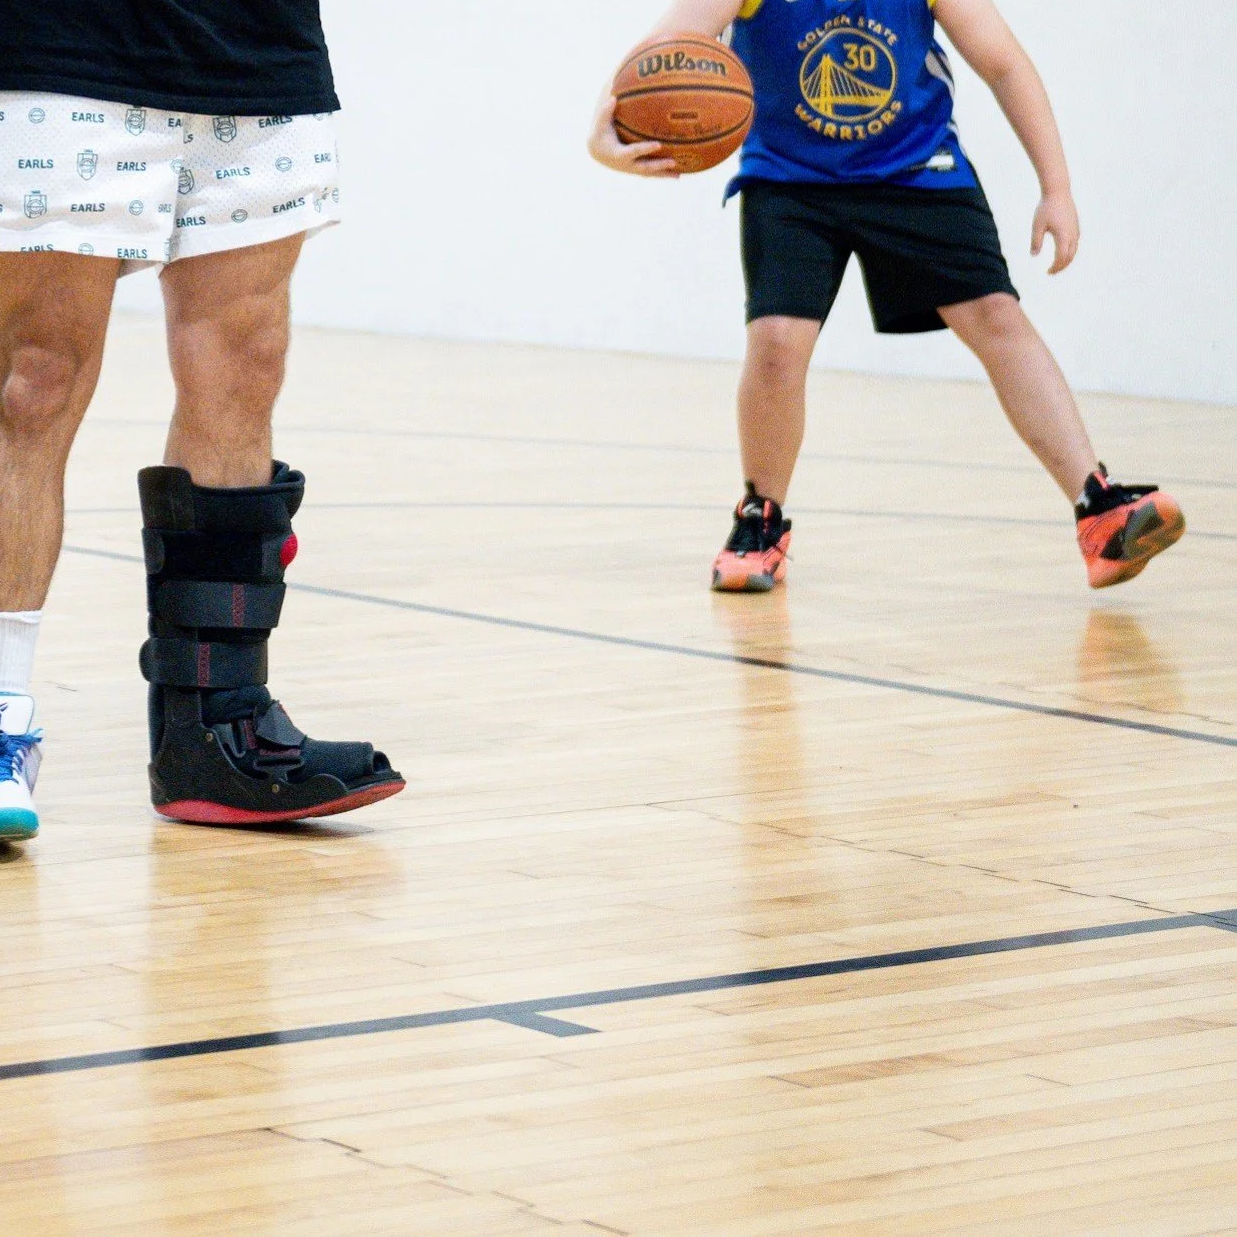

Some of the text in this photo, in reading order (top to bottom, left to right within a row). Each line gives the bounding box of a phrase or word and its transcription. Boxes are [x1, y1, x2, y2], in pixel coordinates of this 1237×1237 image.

[797, 15, 898, 50] GOLDEN STATE
[843, 43, 877, 72] 30
[638, 51, 727, 78] Wilson
[71, 112, 105, 123] EARLS
[258, 115, 293, 128] EARLS
[794, 100, 902, 140] WARRIORS
[18, 159, 54, 169] EARLS
[116, 161, 147, 171] EARLS
[215, 167, 251, 180] EARLS
[70, 203, 105, 212] EARLS
[272, 197, 306, 213] EARLS
[176, 216, 206, 228] EARLS
[117, 248, 148, 259] EARLS
